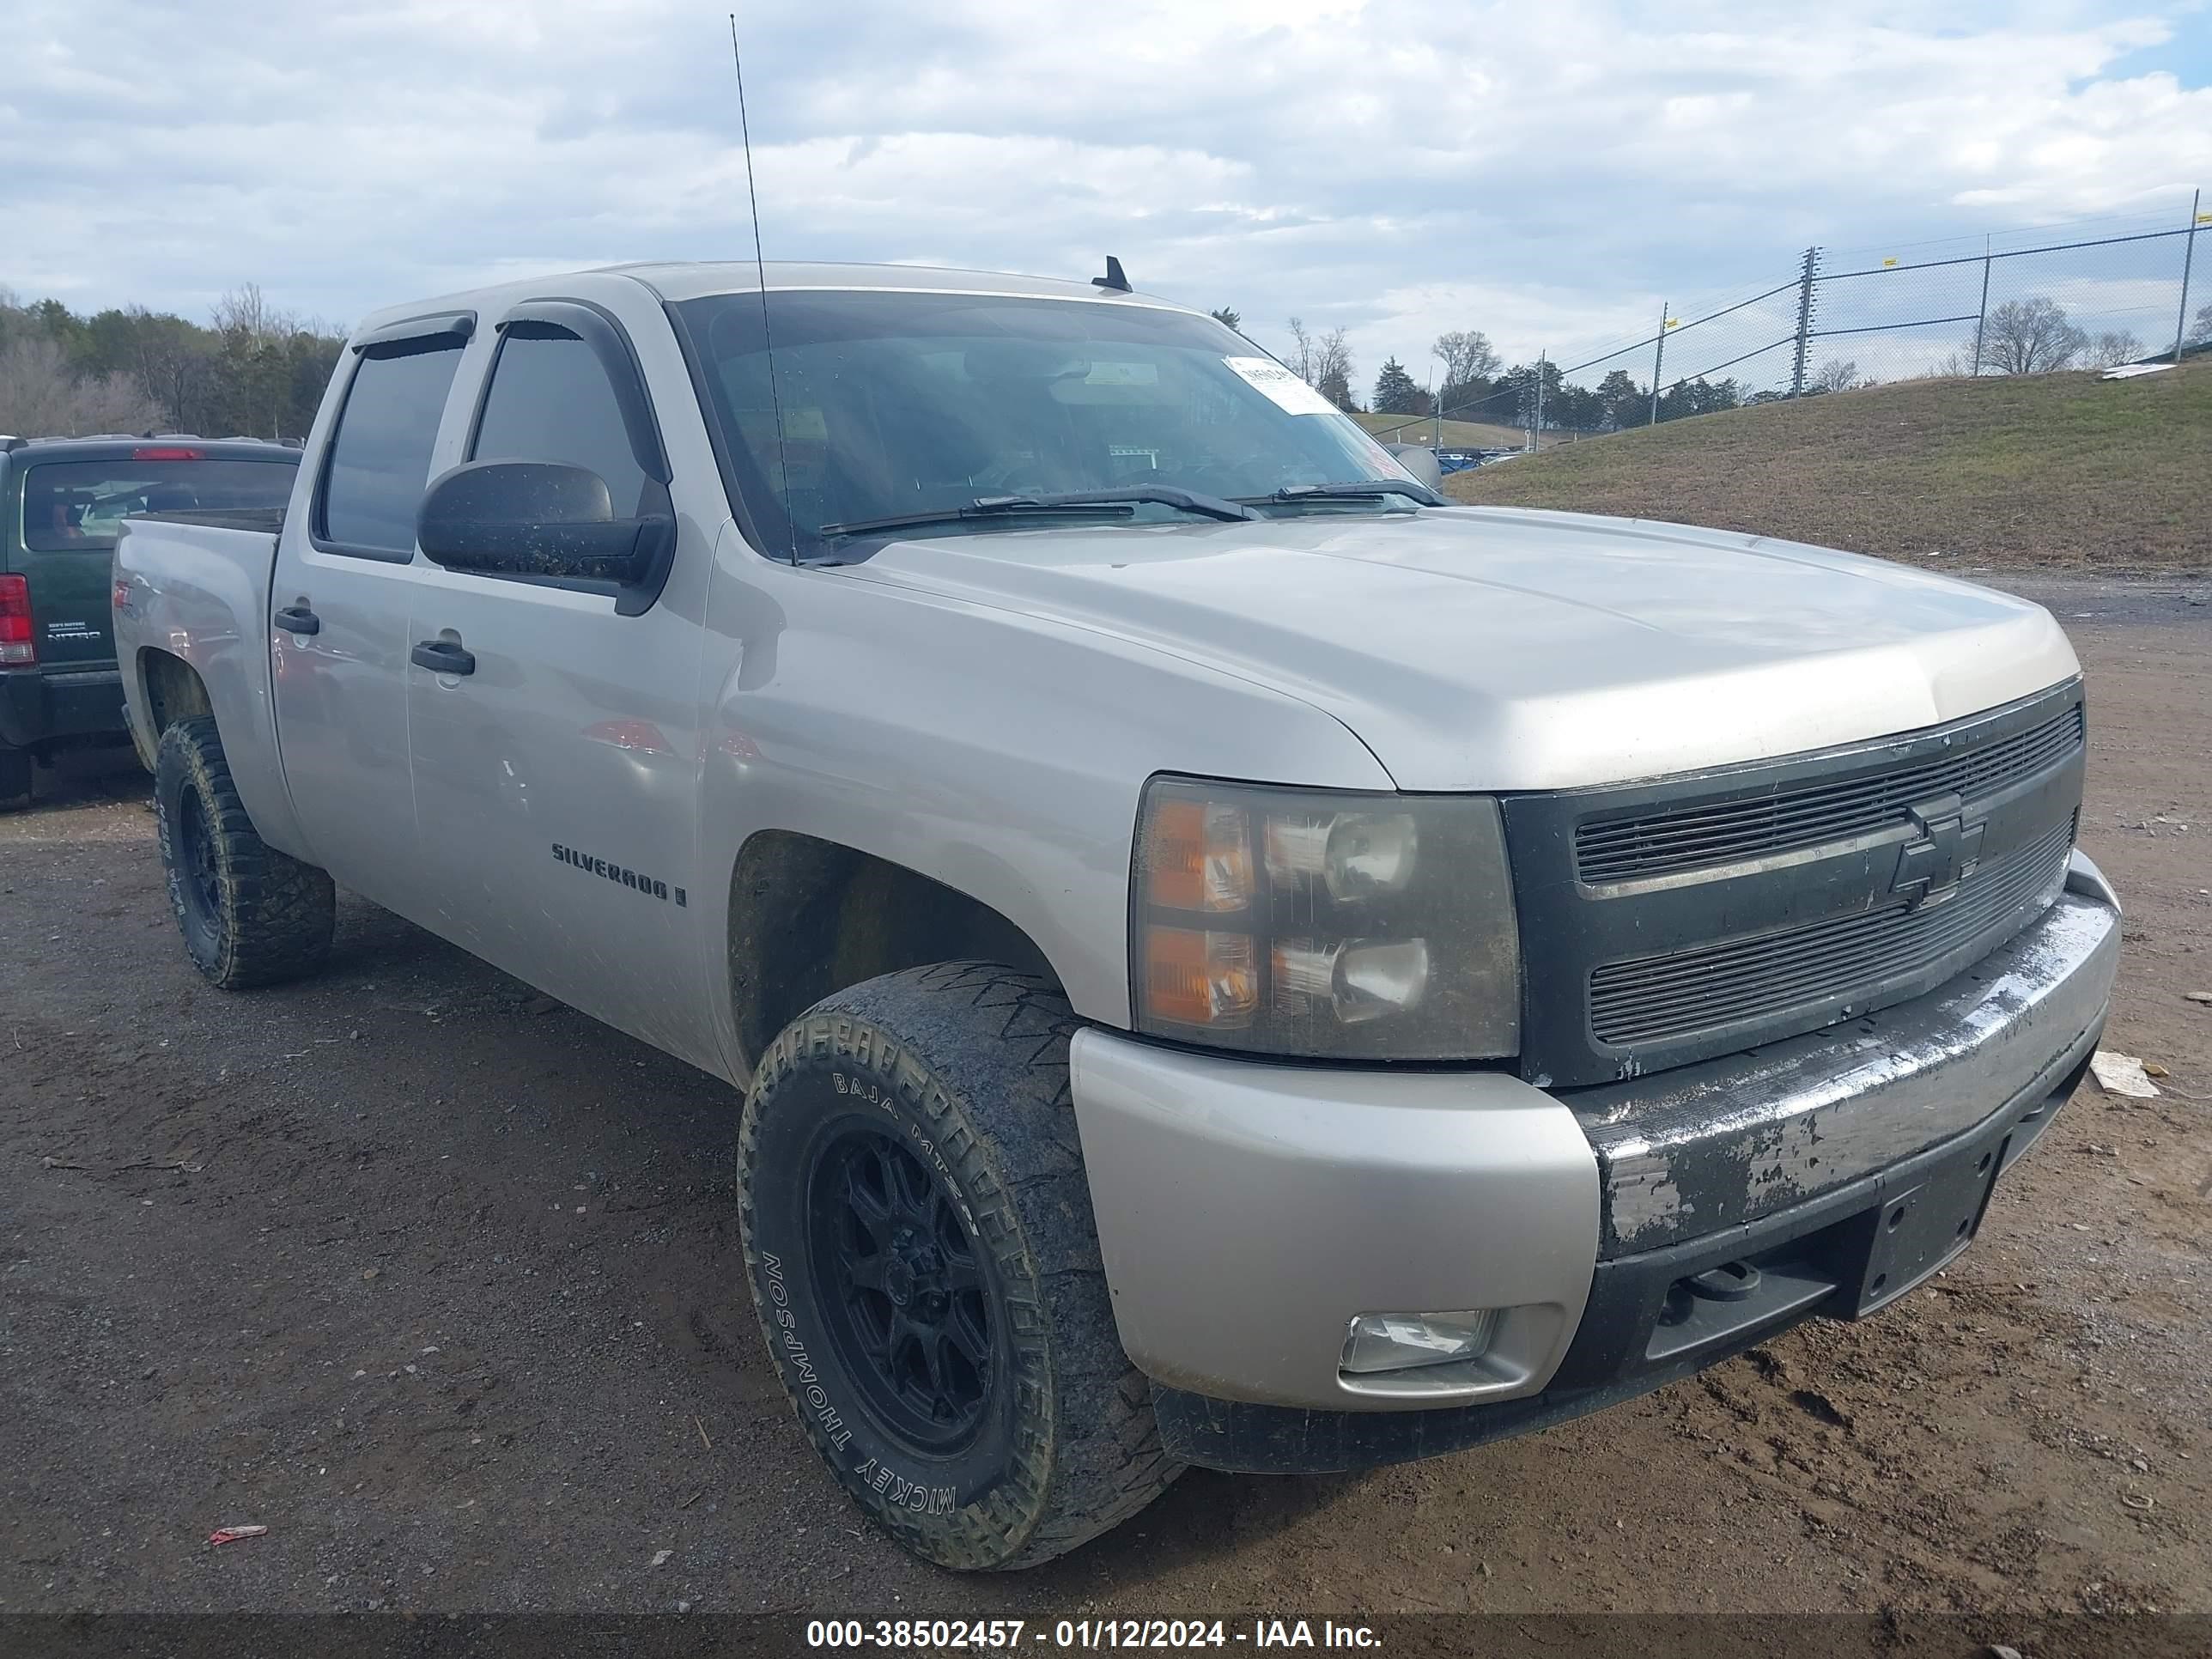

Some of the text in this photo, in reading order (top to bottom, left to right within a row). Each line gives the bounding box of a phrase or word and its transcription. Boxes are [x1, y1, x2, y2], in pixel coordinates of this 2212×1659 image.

[551, 842, 667, 900] SILVERADO
[833, 1073, 899, 1121] BAJA
[911, 1123, 963, 1200] MTZ
[763, 1250, 957, 1516] MICKEY THOMPSON
